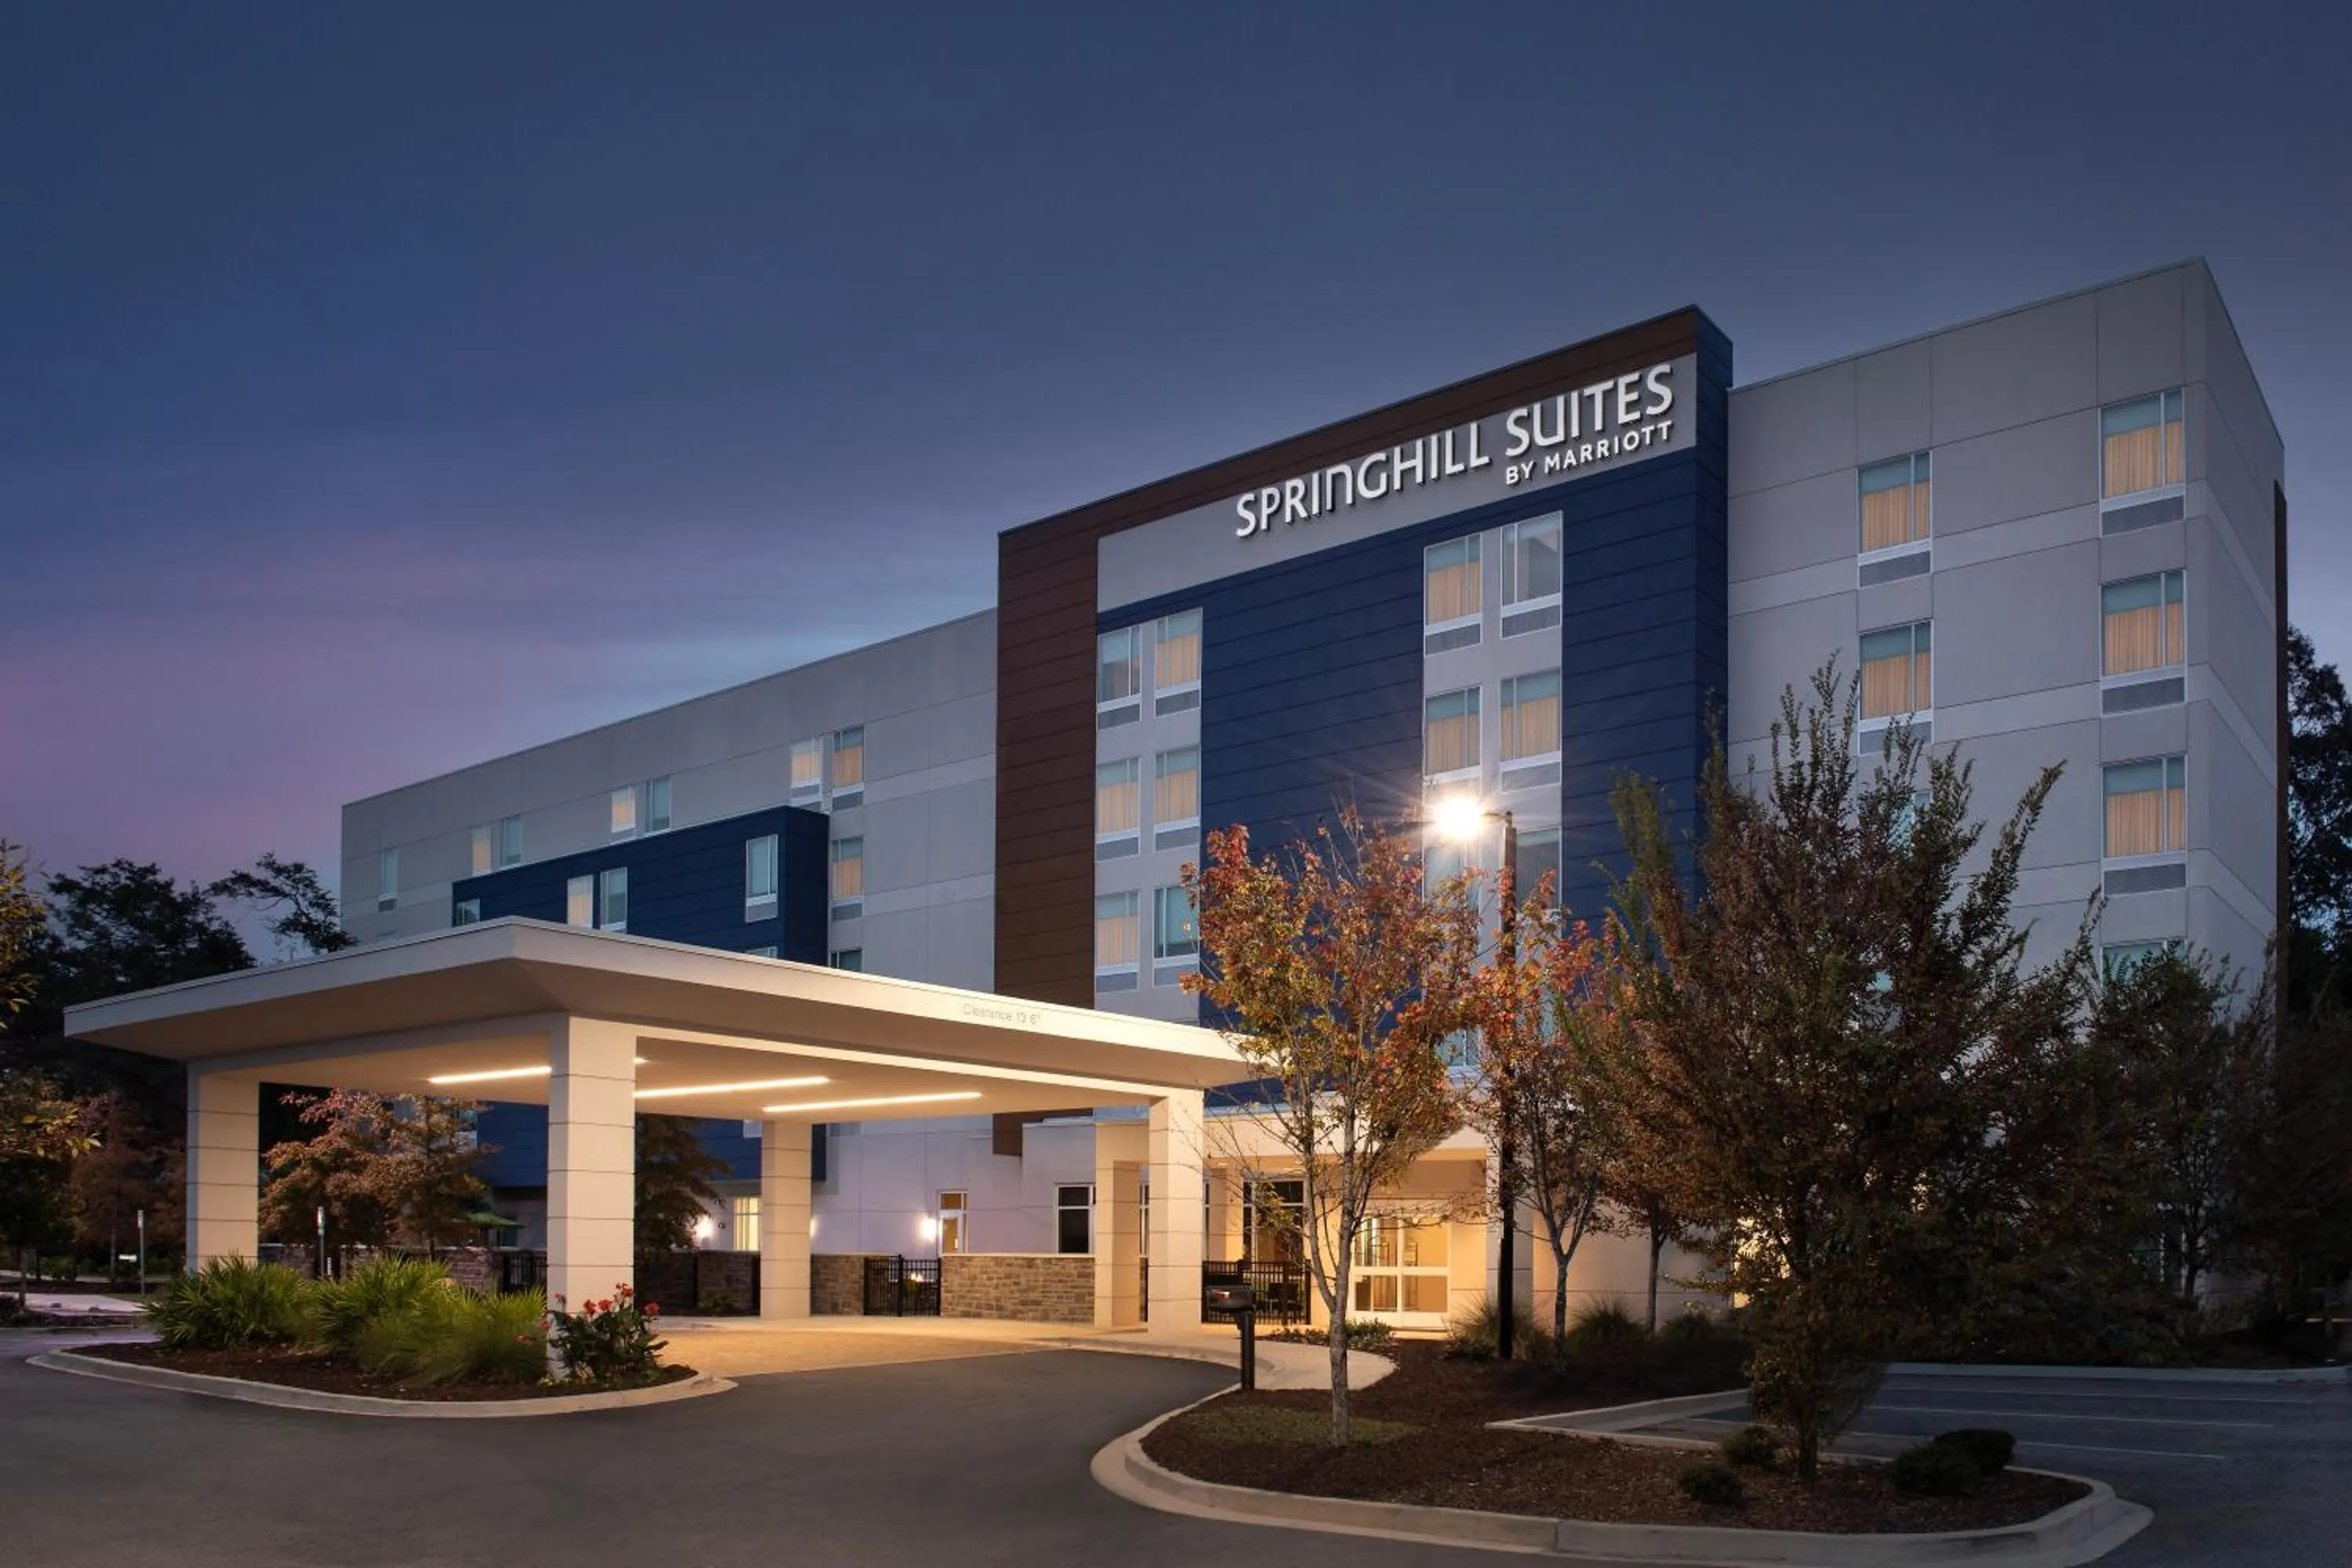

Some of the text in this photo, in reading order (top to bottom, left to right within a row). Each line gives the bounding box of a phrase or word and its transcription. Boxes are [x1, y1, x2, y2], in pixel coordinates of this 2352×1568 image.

[1236, 364, 1675, 538] SPRINGHILL SUITES
[1505, 420, 1674, 487] BY MARRIOTT
[963, 1003, 1013, 1022] Clearance
